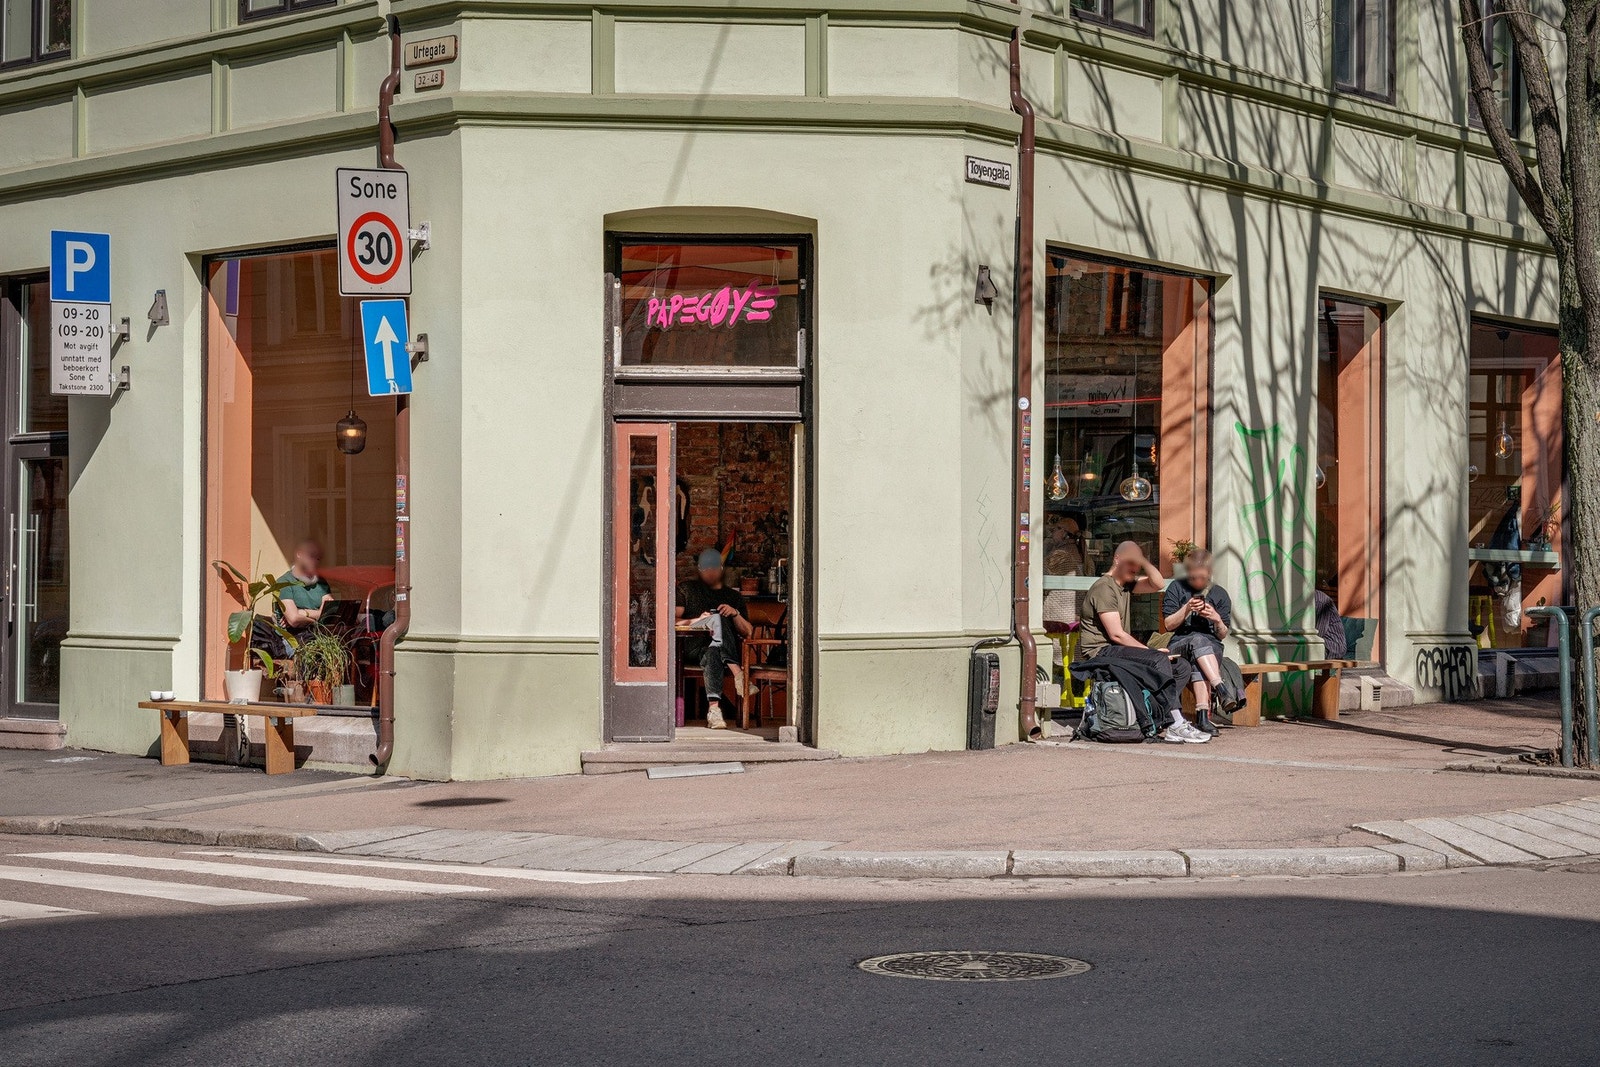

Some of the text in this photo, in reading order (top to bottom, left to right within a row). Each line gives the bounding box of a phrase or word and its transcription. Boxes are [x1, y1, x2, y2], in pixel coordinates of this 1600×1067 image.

[413, 42, 446, 60] Urtegata
[418, 73, 439, 86] 32-48
[969, 160, 1010, 181] Tøyengata
[350, 176, 397, 200] Sone
[357, 231, 393, 265] 30
[65, 241, 96, 292] P
[646, 278, 781, 329] PAPEGØYE
[63, 307, 99, 320] 09-20
[58, 324, 104, 338] (09-20)
[63, 342, 99, 352] Mot avgift
[61, 355, 102, 363] unntatt med
[63, 364, 99, 372] beboerkort
[69, 373, 86, 381] Sone
